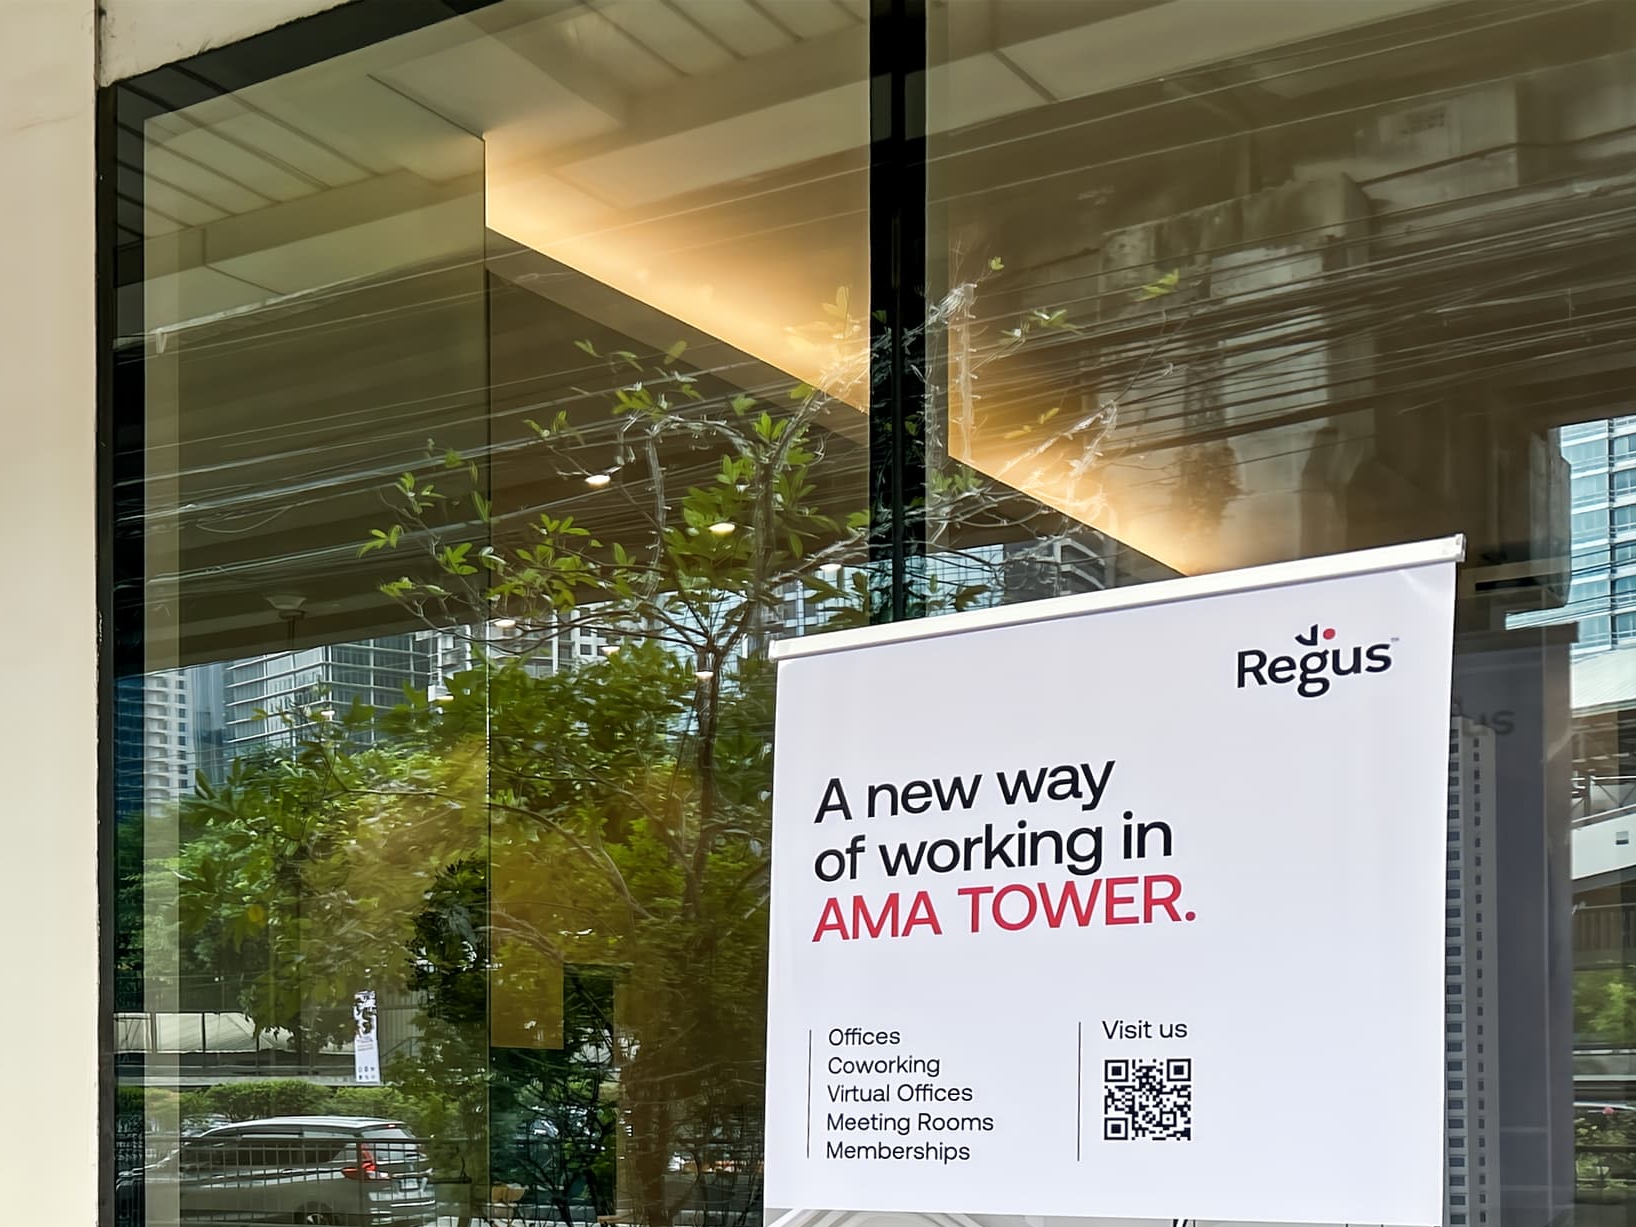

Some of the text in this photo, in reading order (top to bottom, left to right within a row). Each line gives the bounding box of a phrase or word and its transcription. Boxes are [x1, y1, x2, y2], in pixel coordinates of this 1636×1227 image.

[1237, 624, 1392, 698] Regus
[814, 760, 1116, 823] A new way
[815, 811, 1172, 882] of working in
[812, 874, 1196, 942] AMA TOWER.
[829, 1027, 900, 1046] Offices
[1102, 1020, 1187, 1039] Visit us
[828, 1055, 940, 1077] Coworking
[827, 1083, 973, 1102] Virtual Offices
[827, 1113, 994, 1135] Meeting Rooms
[827, 1141, 970, 1165] Memberships
